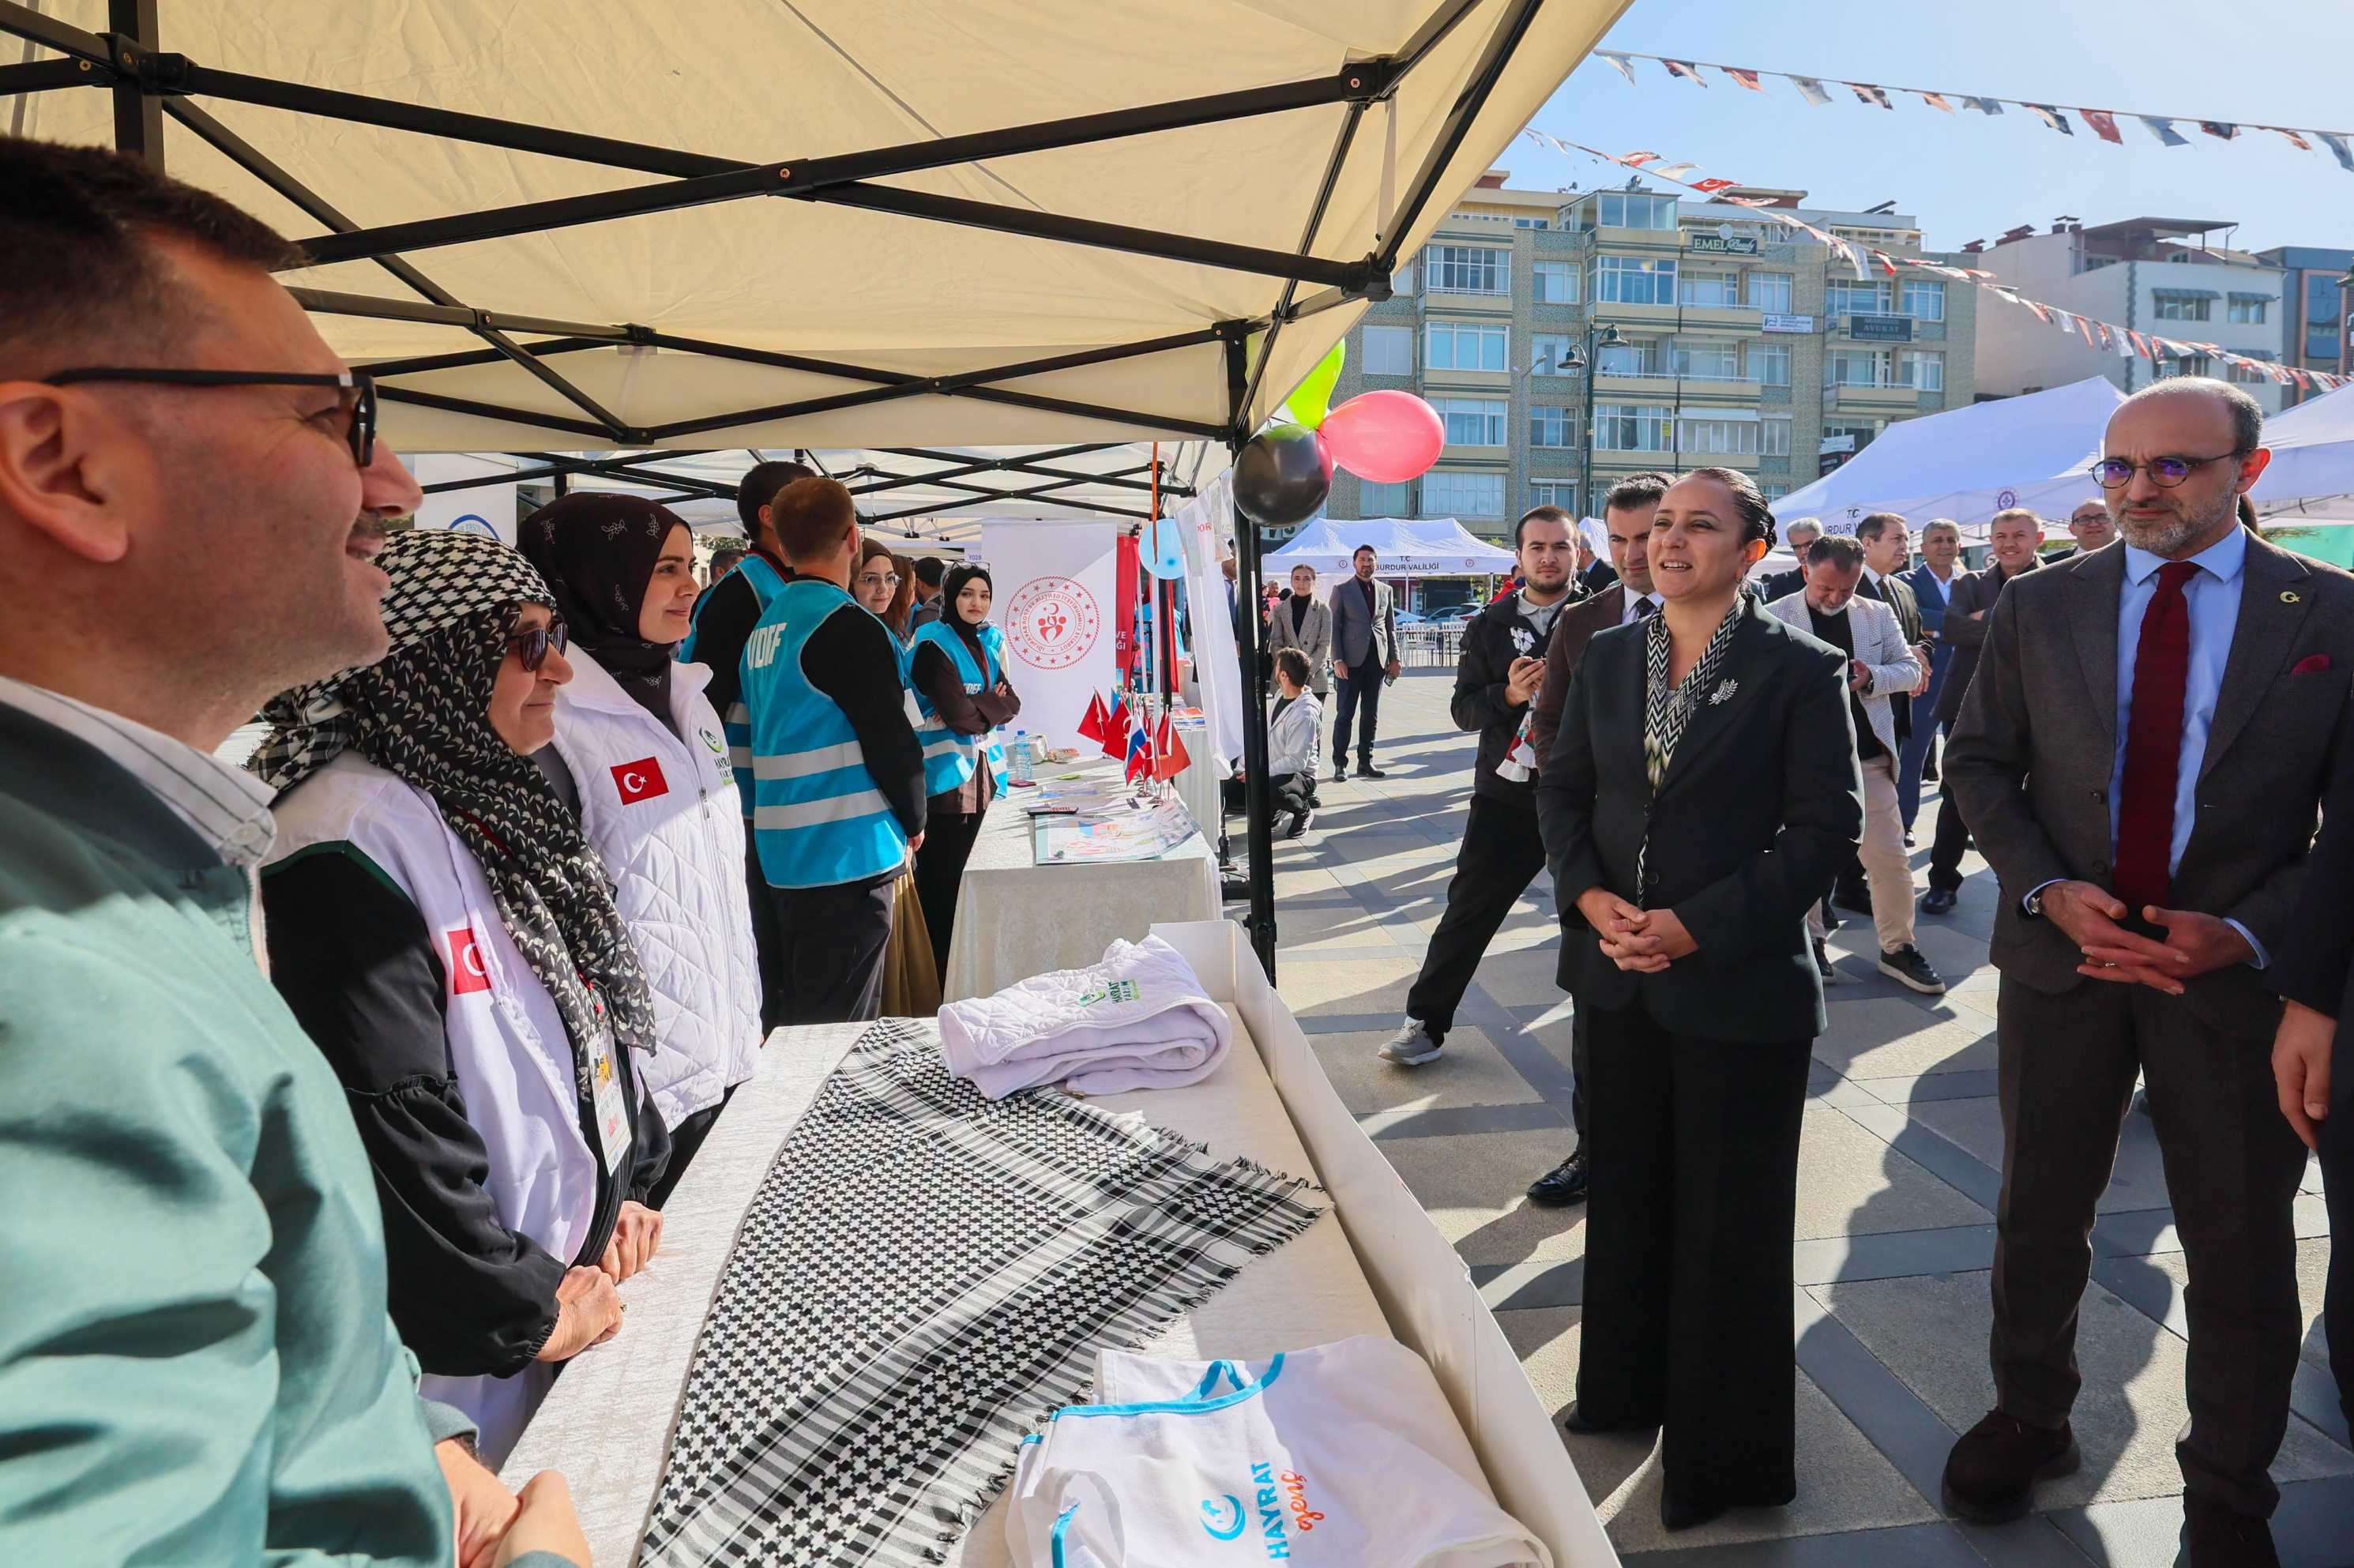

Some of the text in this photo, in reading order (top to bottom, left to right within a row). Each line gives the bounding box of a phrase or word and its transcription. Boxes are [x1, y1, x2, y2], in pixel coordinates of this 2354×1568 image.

[1694, 238, 1728, 250] EMEL
[1408, 562, 1439, 570] VALİLİĞİ
[1107, 981, 1123, 1004] HAYRAT
[1250, 1461, 1291, 1560] HAYRAT
[1280, 1469, 1326, 1531] genç
